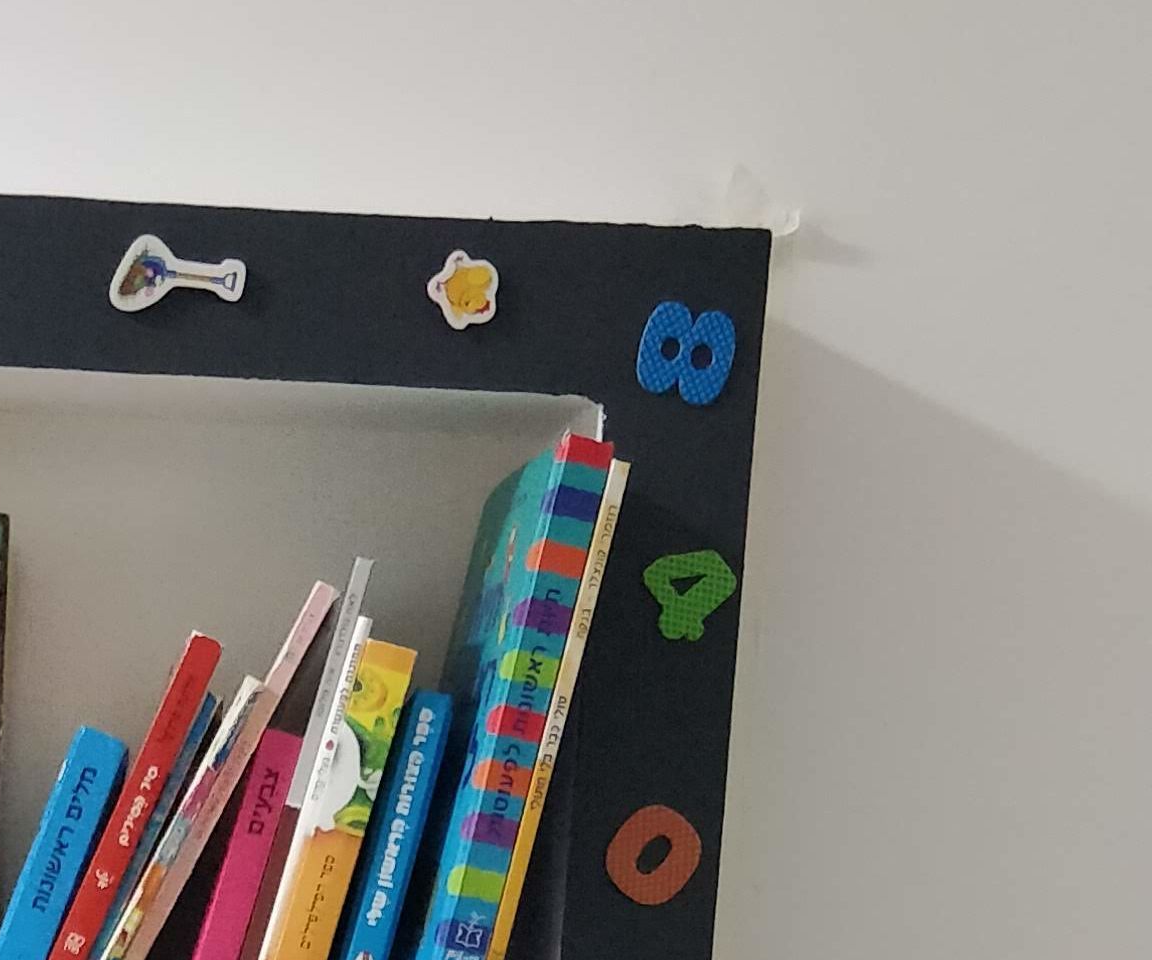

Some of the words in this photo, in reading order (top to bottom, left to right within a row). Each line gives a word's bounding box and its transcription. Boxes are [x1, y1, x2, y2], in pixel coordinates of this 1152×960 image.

[636, 300, 737, 406] 8
[644, 549, 737, 641] 4
[65, 766, 98, 823] מלים
[140, 764, 161, 792] סיר
[247, 766, 280, 836] צבעים
[31, 824, 76, 914] ראשונות
